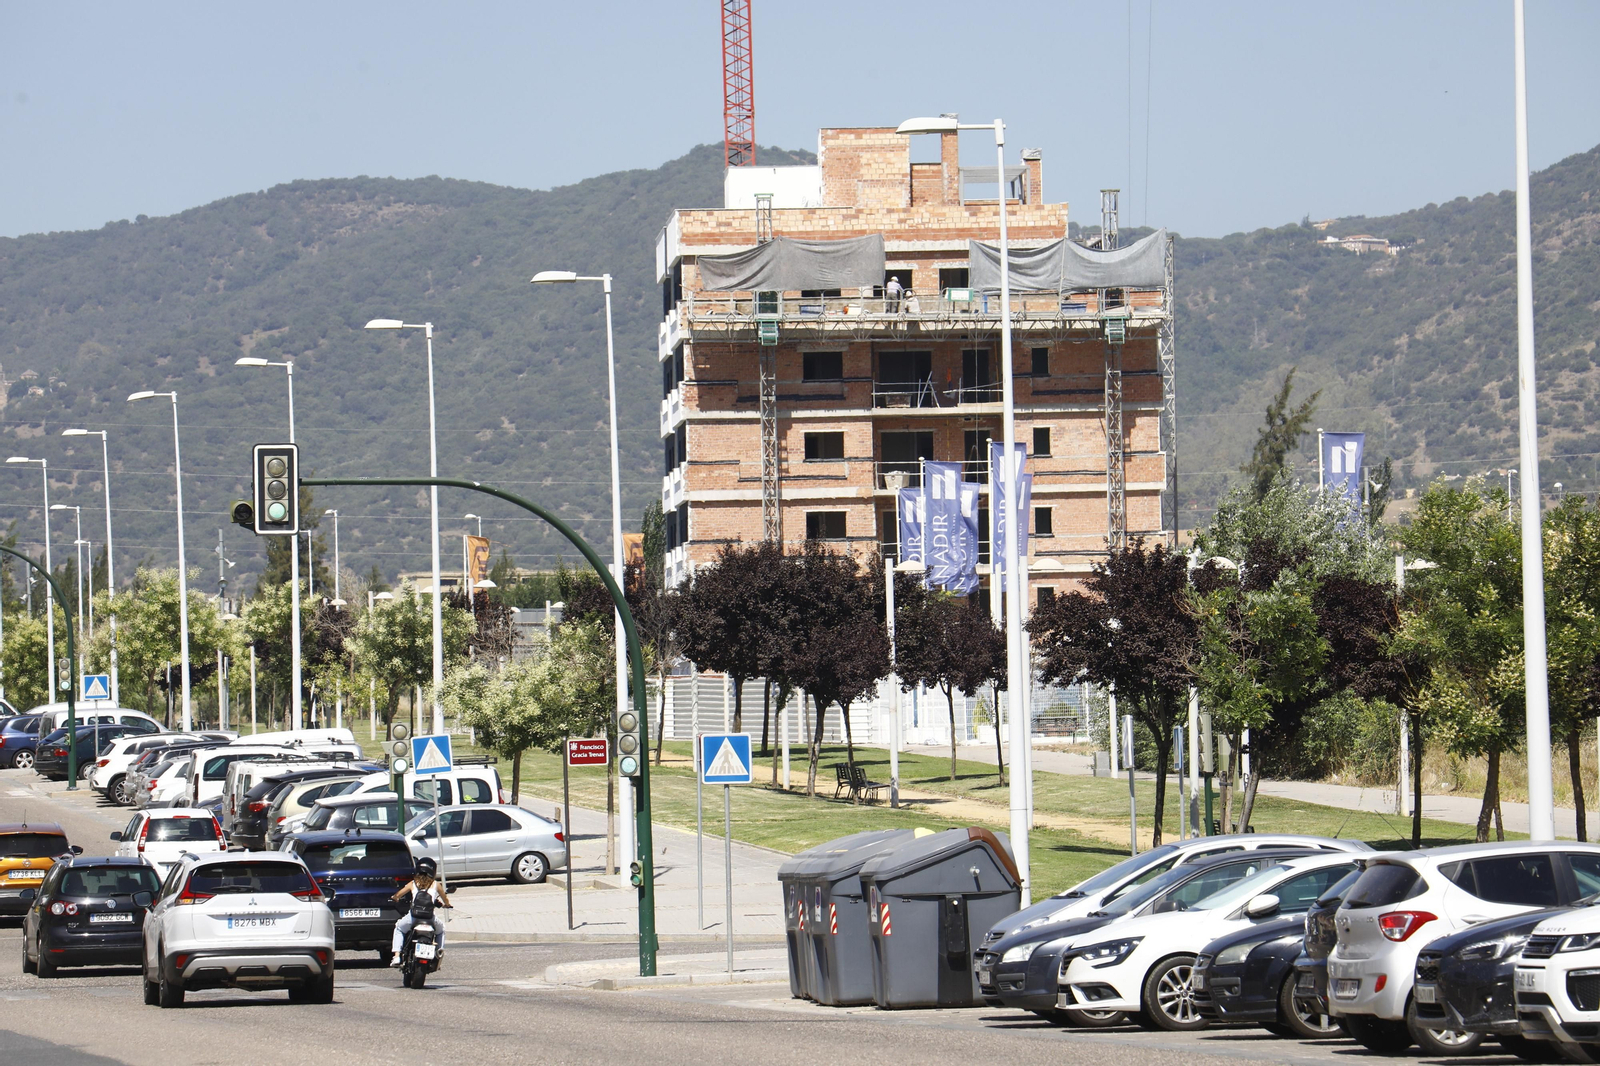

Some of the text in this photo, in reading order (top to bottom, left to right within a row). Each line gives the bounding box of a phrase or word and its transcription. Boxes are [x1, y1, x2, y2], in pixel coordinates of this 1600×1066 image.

[907, 535, 922, 562] DIR
[932, 513, 950, 579] NADIR
[234, 917, 277, 927] 8276 MBX
